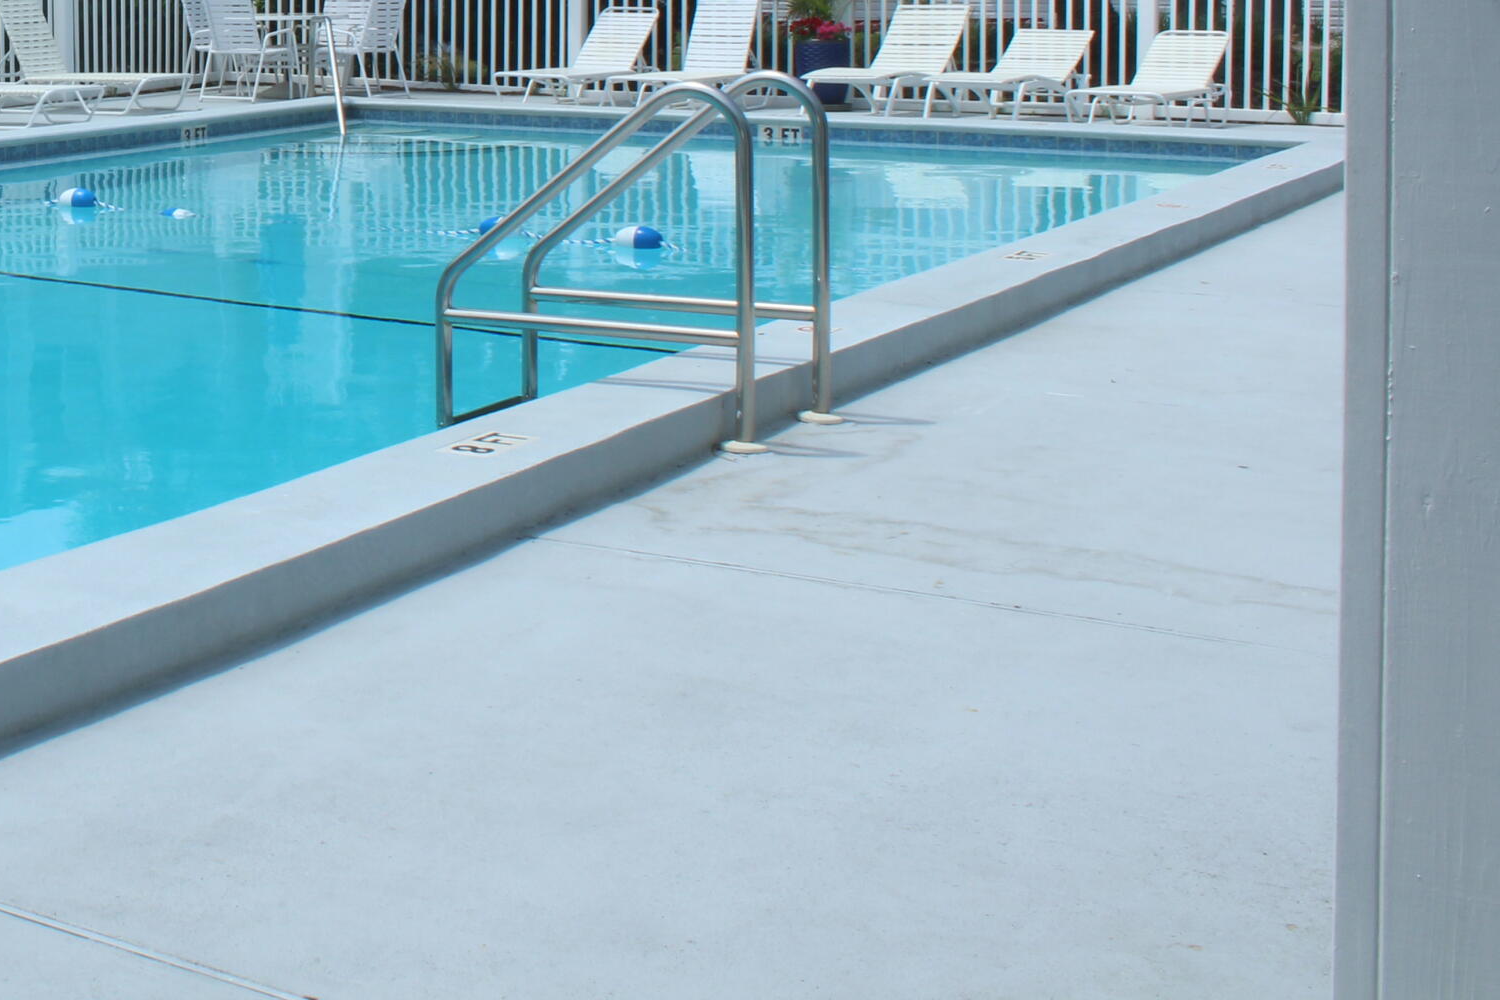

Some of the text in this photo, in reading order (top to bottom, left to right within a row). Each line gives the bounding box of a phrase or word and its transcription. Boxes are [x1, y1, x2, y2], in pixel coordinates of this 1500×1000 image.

[763, 126, 800, 140] 3 FT
[450, 431, 529, 454] 8 FT
